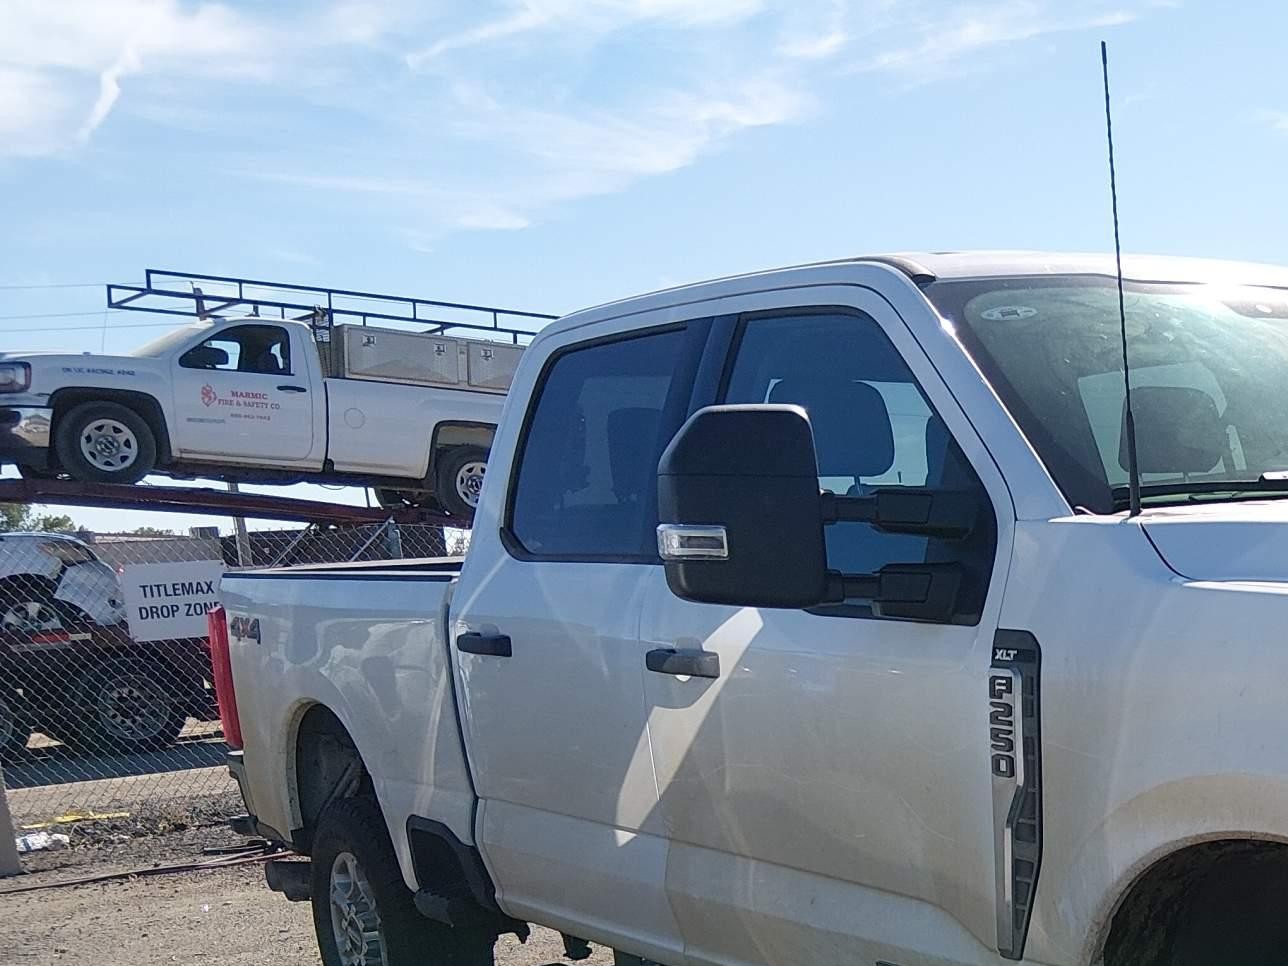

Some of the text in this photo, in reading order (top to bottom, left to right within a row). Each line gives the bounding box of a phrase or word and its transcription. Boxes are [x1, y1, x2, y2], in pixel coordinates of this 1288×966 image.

[230, 390, 268, 400] MARMIC
[140, 581, 215, 598] TITLEMAX
[139, 604, 179, 620] DROP
[994, 648, 1018, 660] XLT
